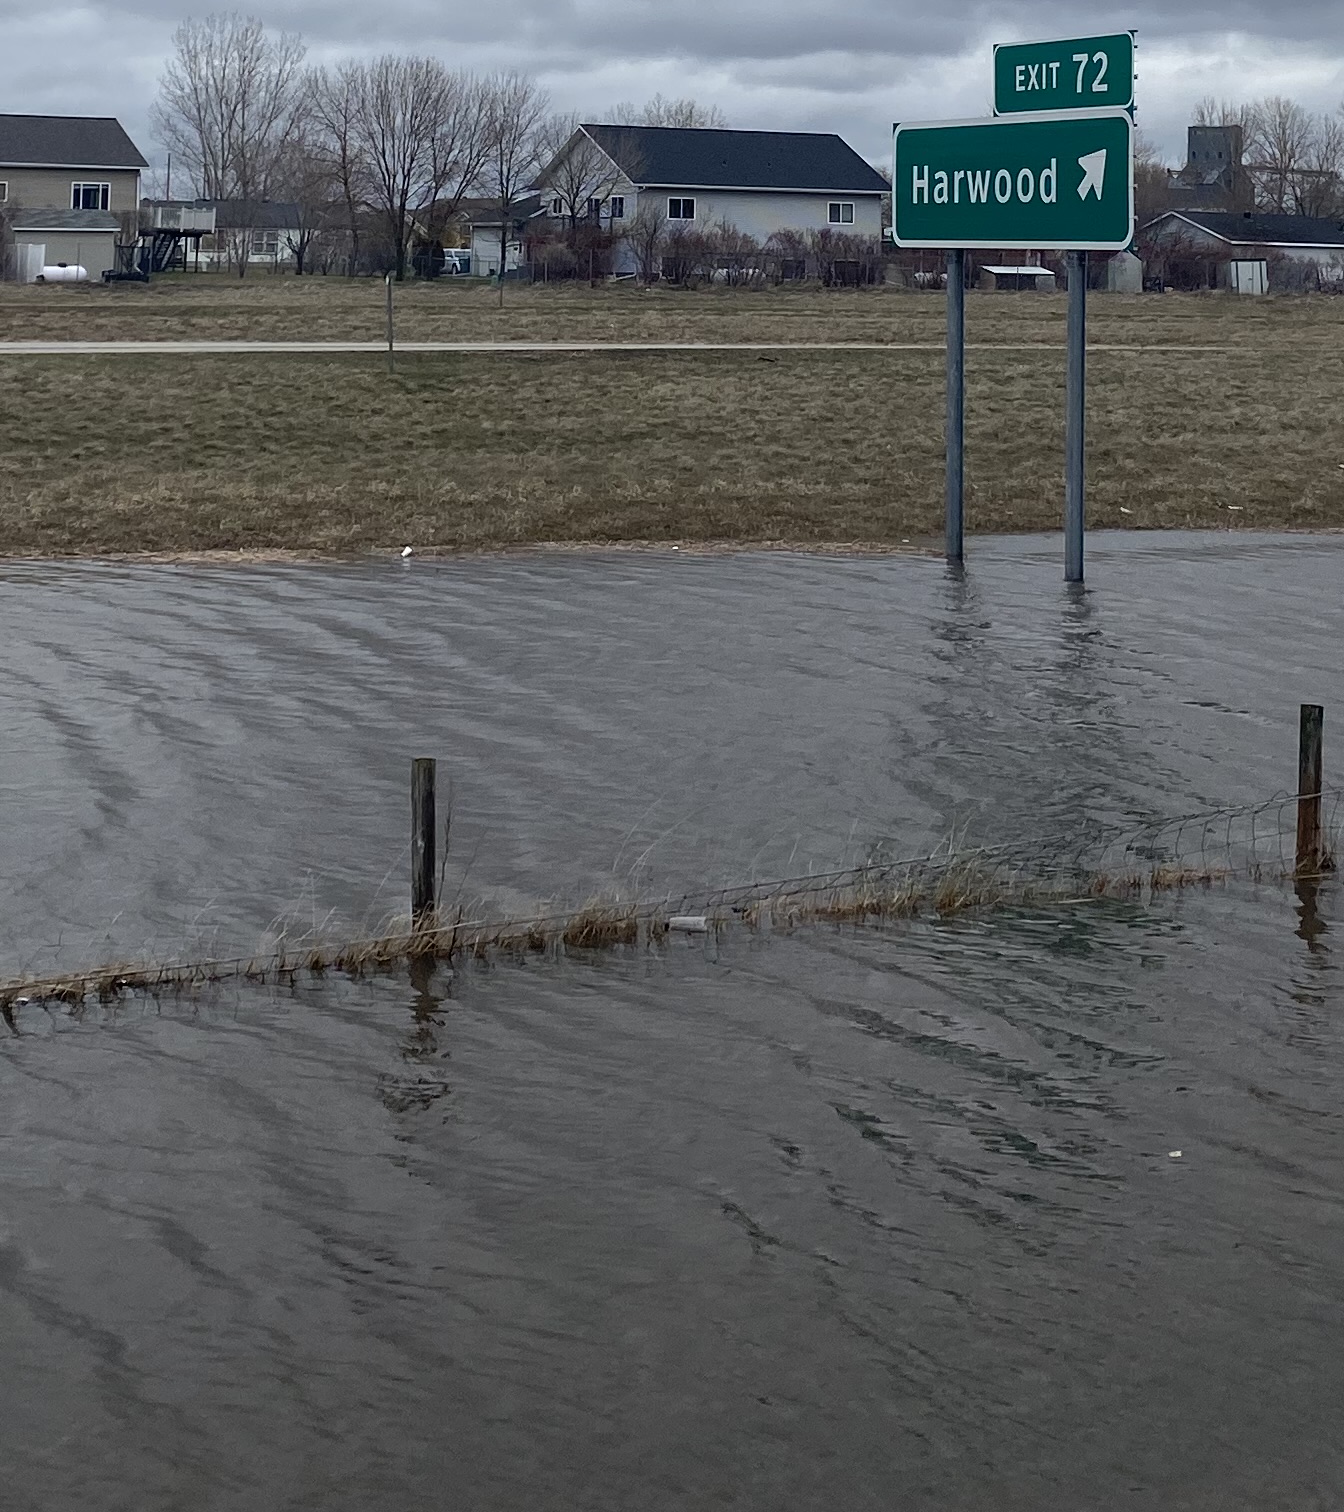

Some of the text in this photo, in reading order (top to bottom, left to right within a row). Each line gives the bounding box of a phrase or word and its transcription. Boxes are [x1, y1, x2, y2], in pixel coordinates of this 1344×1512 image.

[1015, 51, 1108, 93] EXIT 72
[912, 158, 1057, 204] Harwood
